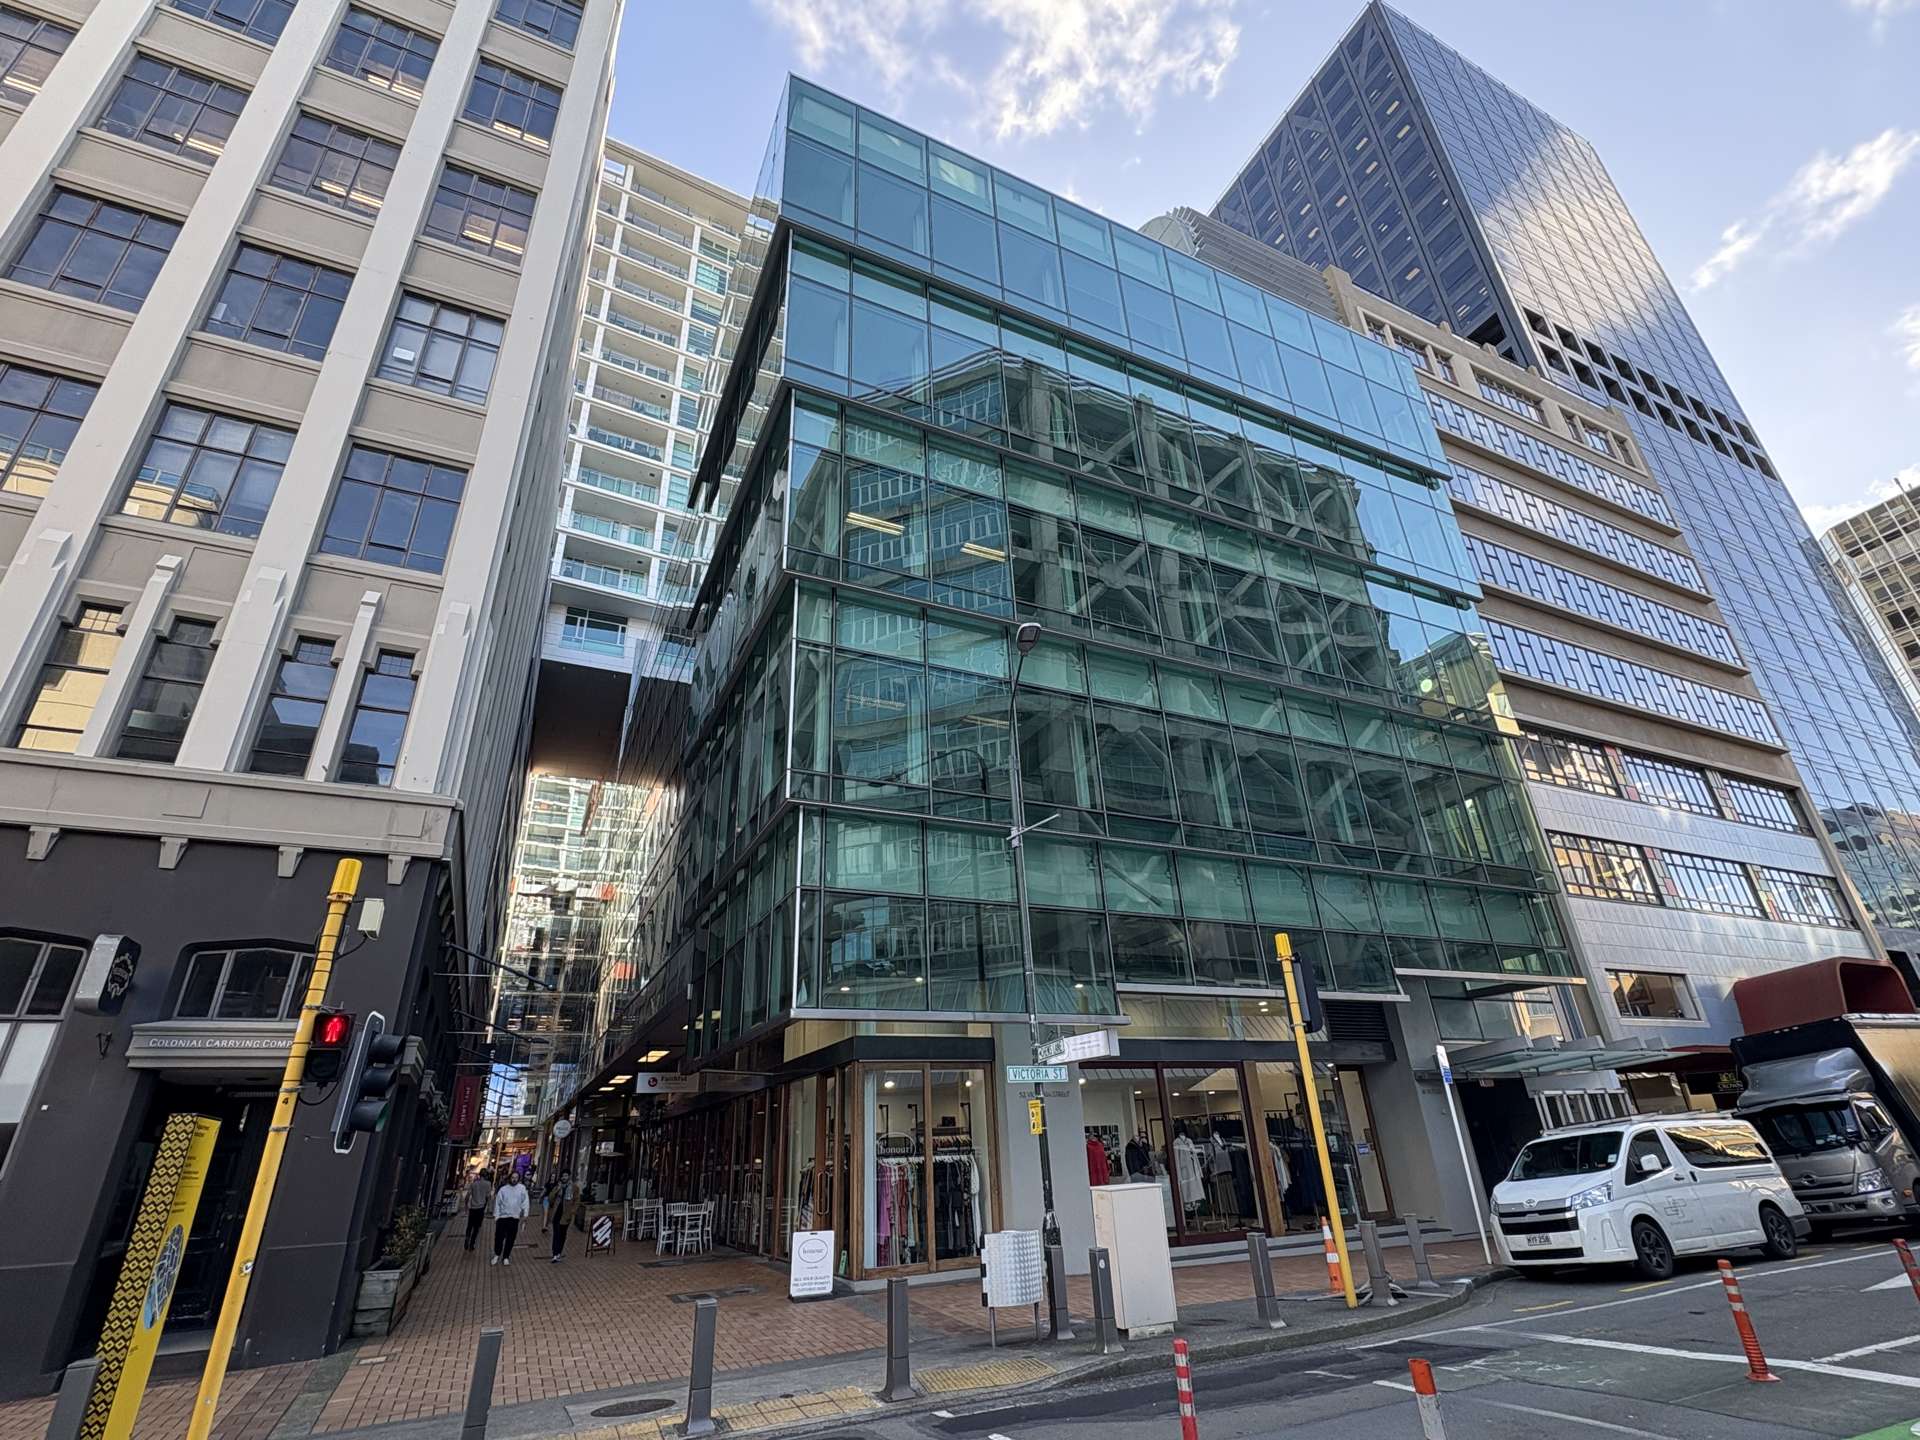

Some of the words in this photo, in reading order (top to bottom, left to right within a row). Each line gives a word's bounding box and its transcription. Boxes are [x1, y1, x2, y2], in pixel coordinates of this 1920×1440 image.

[149, 1038, 202, 1048] COLONIAL
[205, 1038, 260, 1048] CARRYING
[262, 1039, 293, 1049] COMP
[1012, 1067, 1049, 1080] VICTORIA
[1054, 1067, 1063, 1078] ST
[880, 1144, 911, 1154] honour
